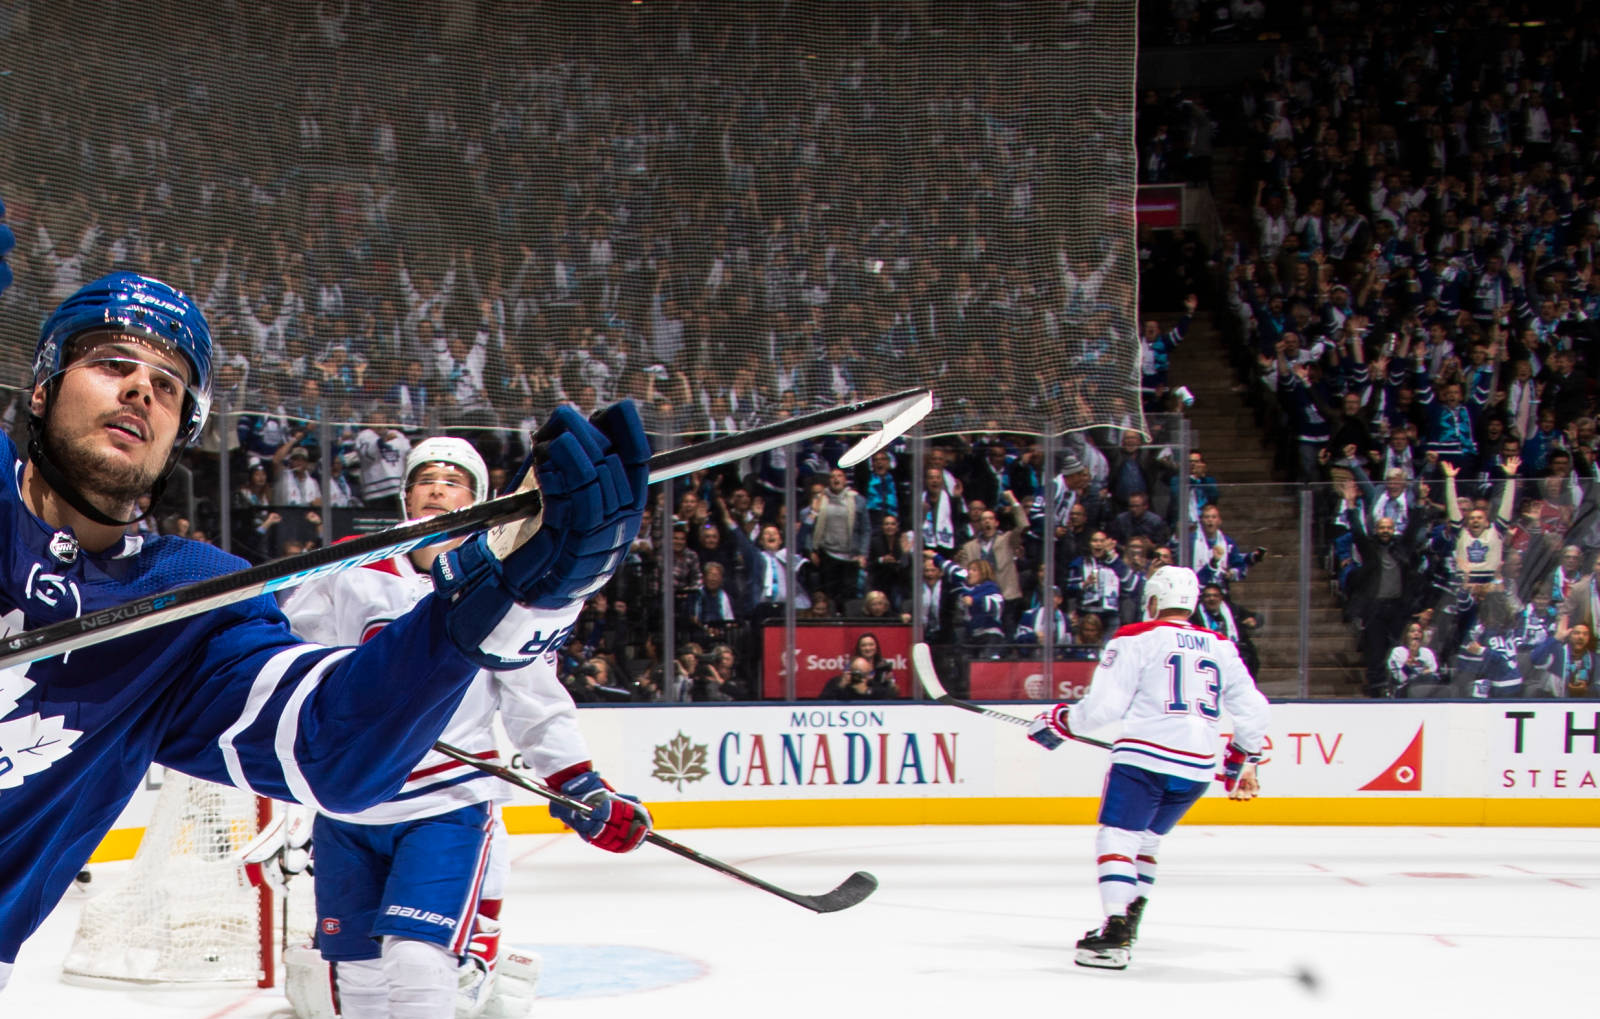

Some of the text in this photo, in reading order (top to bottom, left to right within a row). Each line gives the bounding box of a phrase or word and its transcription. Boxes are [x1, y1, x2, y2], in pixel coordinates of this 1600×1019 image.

[1175, 632, 1211, 653] DOMI
[1164, 651, 1223, 722] 13
[791, 711, 884, 728] MOLSON
[718, 731, 960, 786] CANADIAN
[1287, 732, 1344, 765] TV
[385, 905, 458, 929] BAUER
